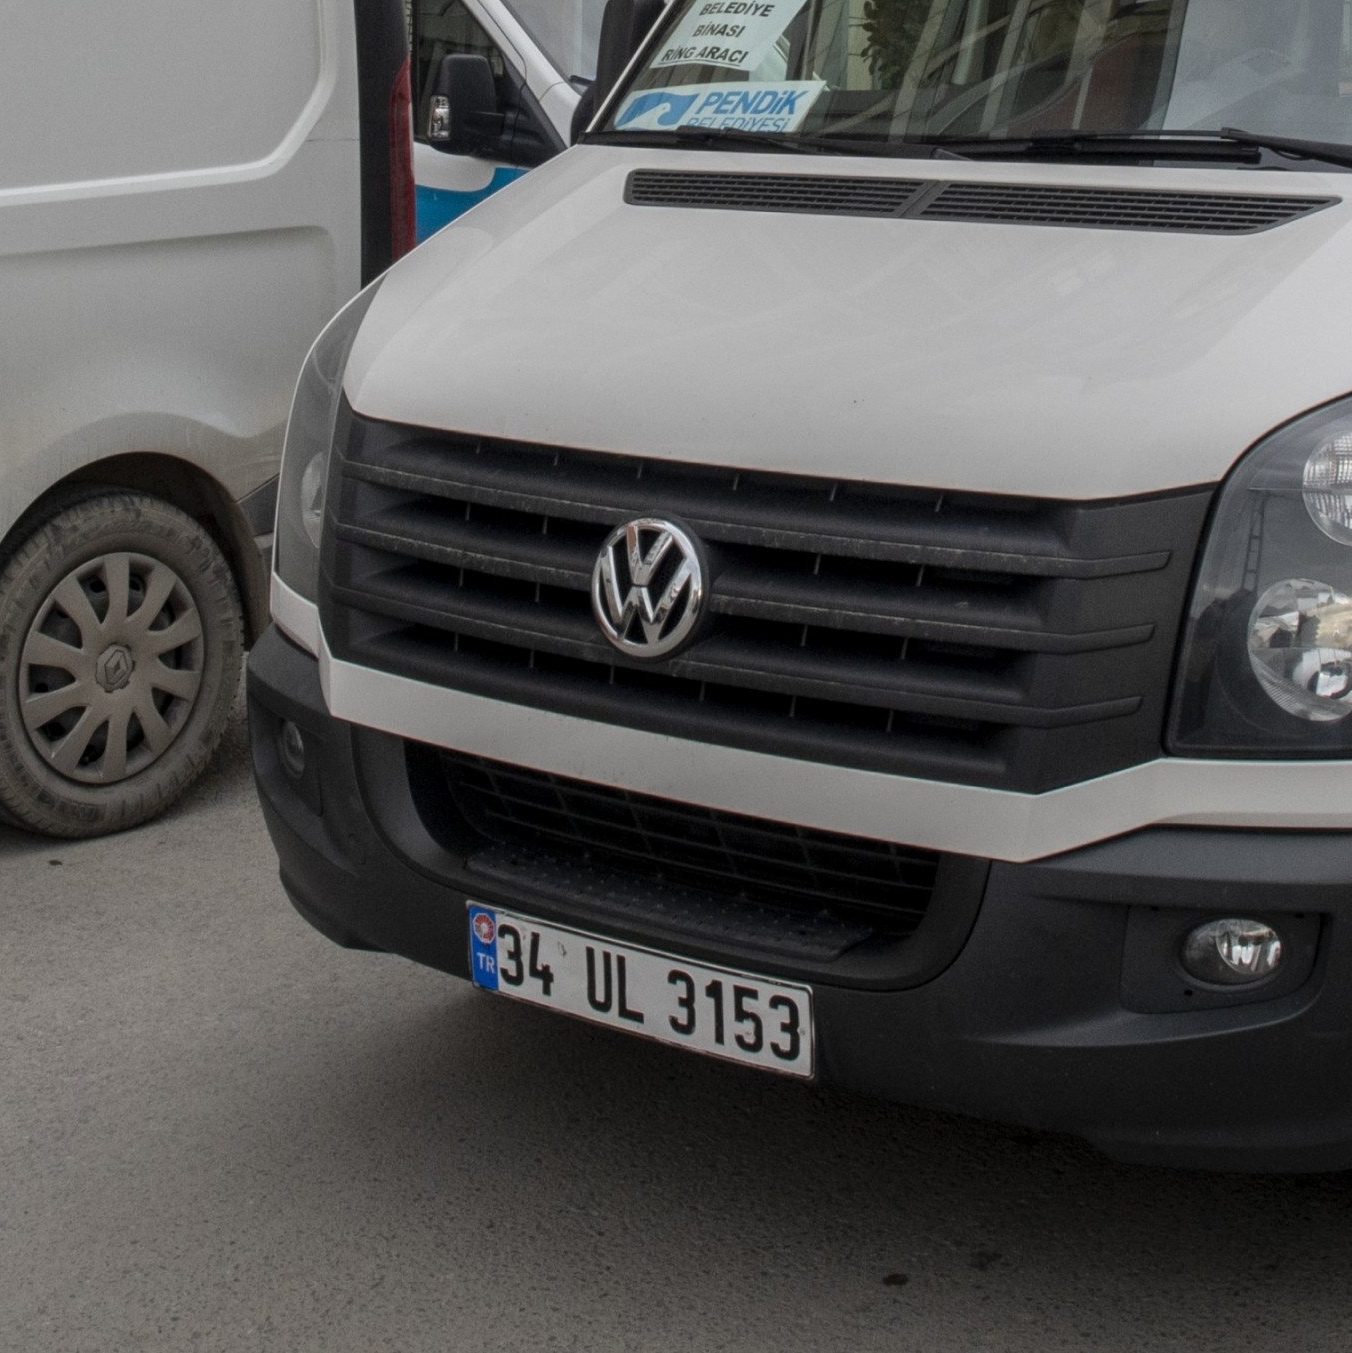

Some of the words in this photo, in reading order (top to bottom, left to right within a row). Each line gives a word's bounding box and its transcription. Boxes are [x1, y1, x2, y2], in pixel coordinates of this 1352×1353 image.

[699, 0, 775, 17] BELEDİYE
[692, 21, 745, 38] BİNASI
[697, 47, 749, 63] ARACI
[477, 951, 495, 974] TR
[497, 923, 554, 997] 34
[585, 946, 645, 1025] UL
[667, 969, 801, 1061] 3153
